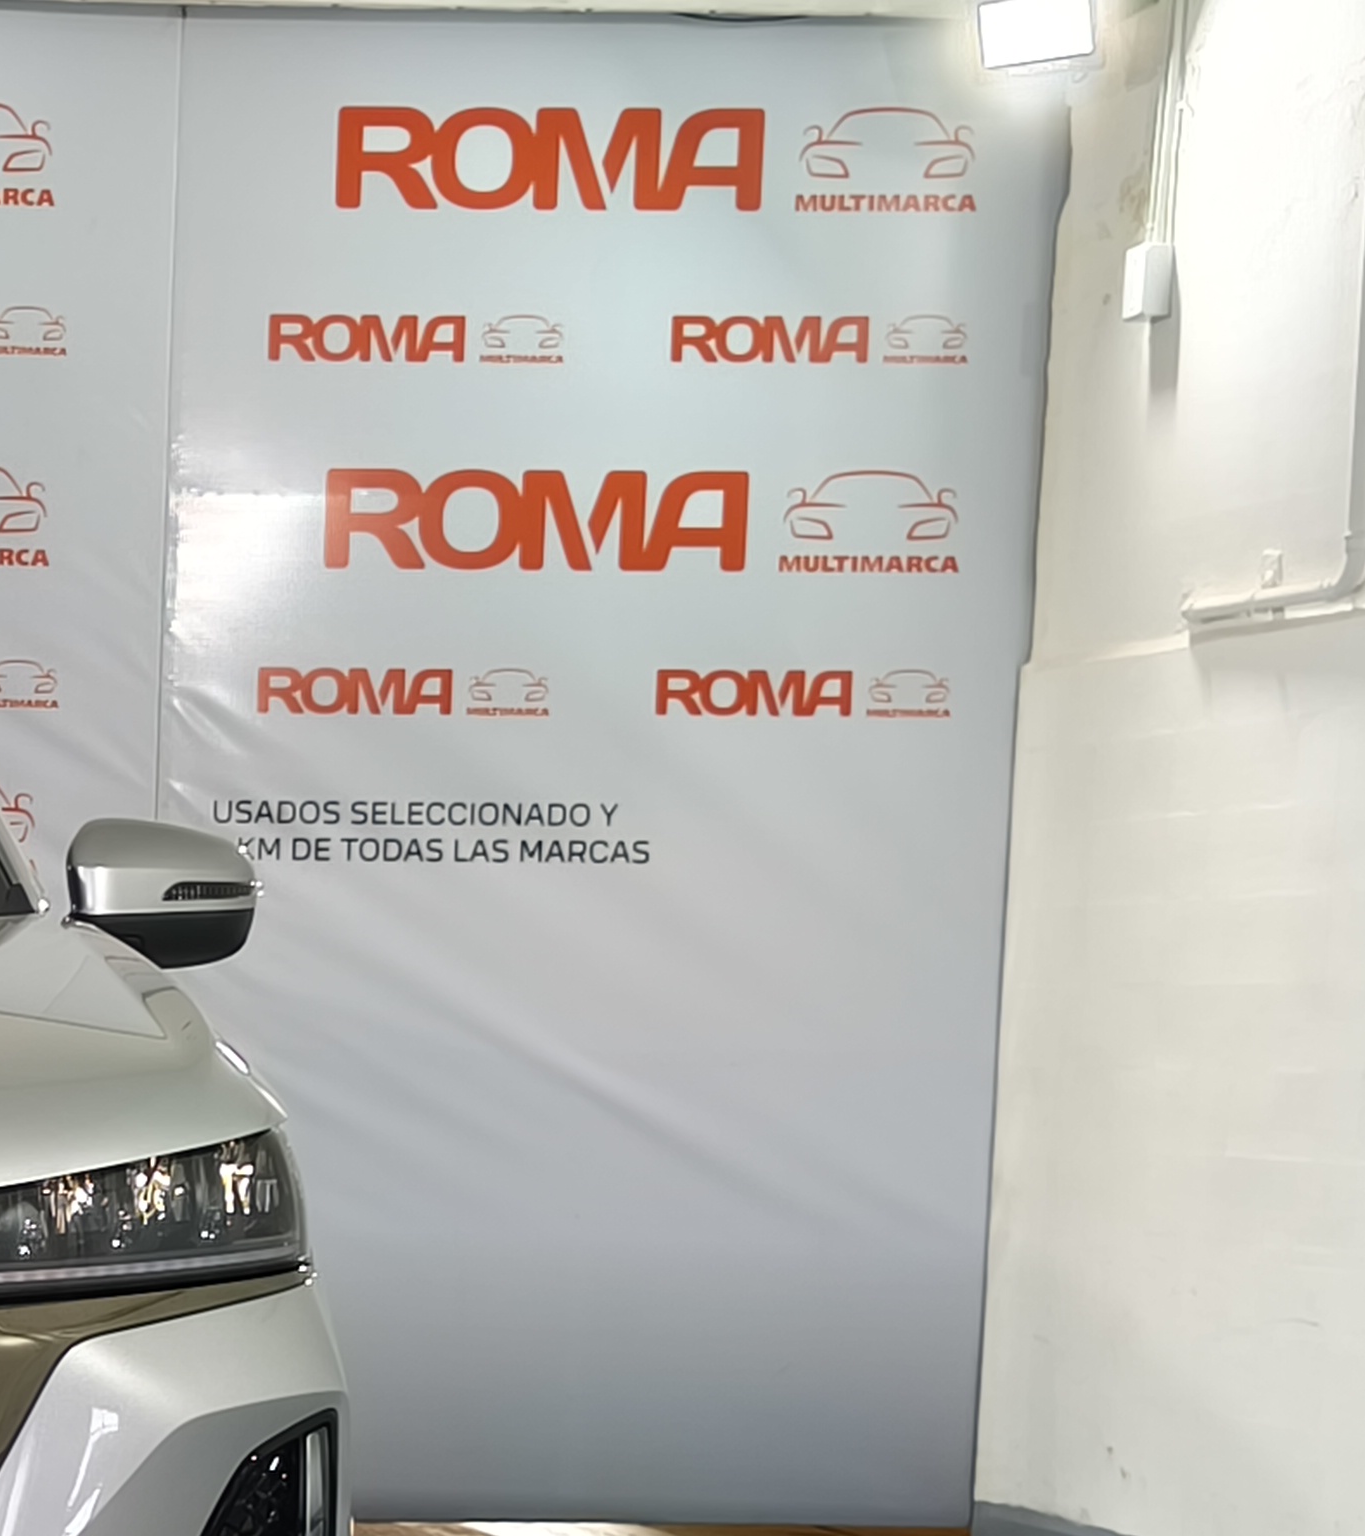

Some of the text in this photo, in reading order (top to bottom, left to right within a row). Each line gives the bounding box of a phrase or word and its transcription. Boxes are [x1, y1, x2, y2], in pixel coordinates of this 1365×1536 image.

[336, 107, 976, 214] ROMA MULTIMARCA
[269, 315, 466, 363] ROMA
[672, 316, 869, 364] ROMA
[326, 469, 959, 574] ROMA MULTIMARCA
[258, 669, 453, 716] ROMA
[657, 670, 853, 717] ROMA
[214, 800, 618, 827] USADOS SELECCIONADO Y
[292, 838, 331, 861] DE
[341, 838, 443, 862] TODAS
[454, 839, 509, 863] LAS
[520, 840, 649, 864] MARCAS
